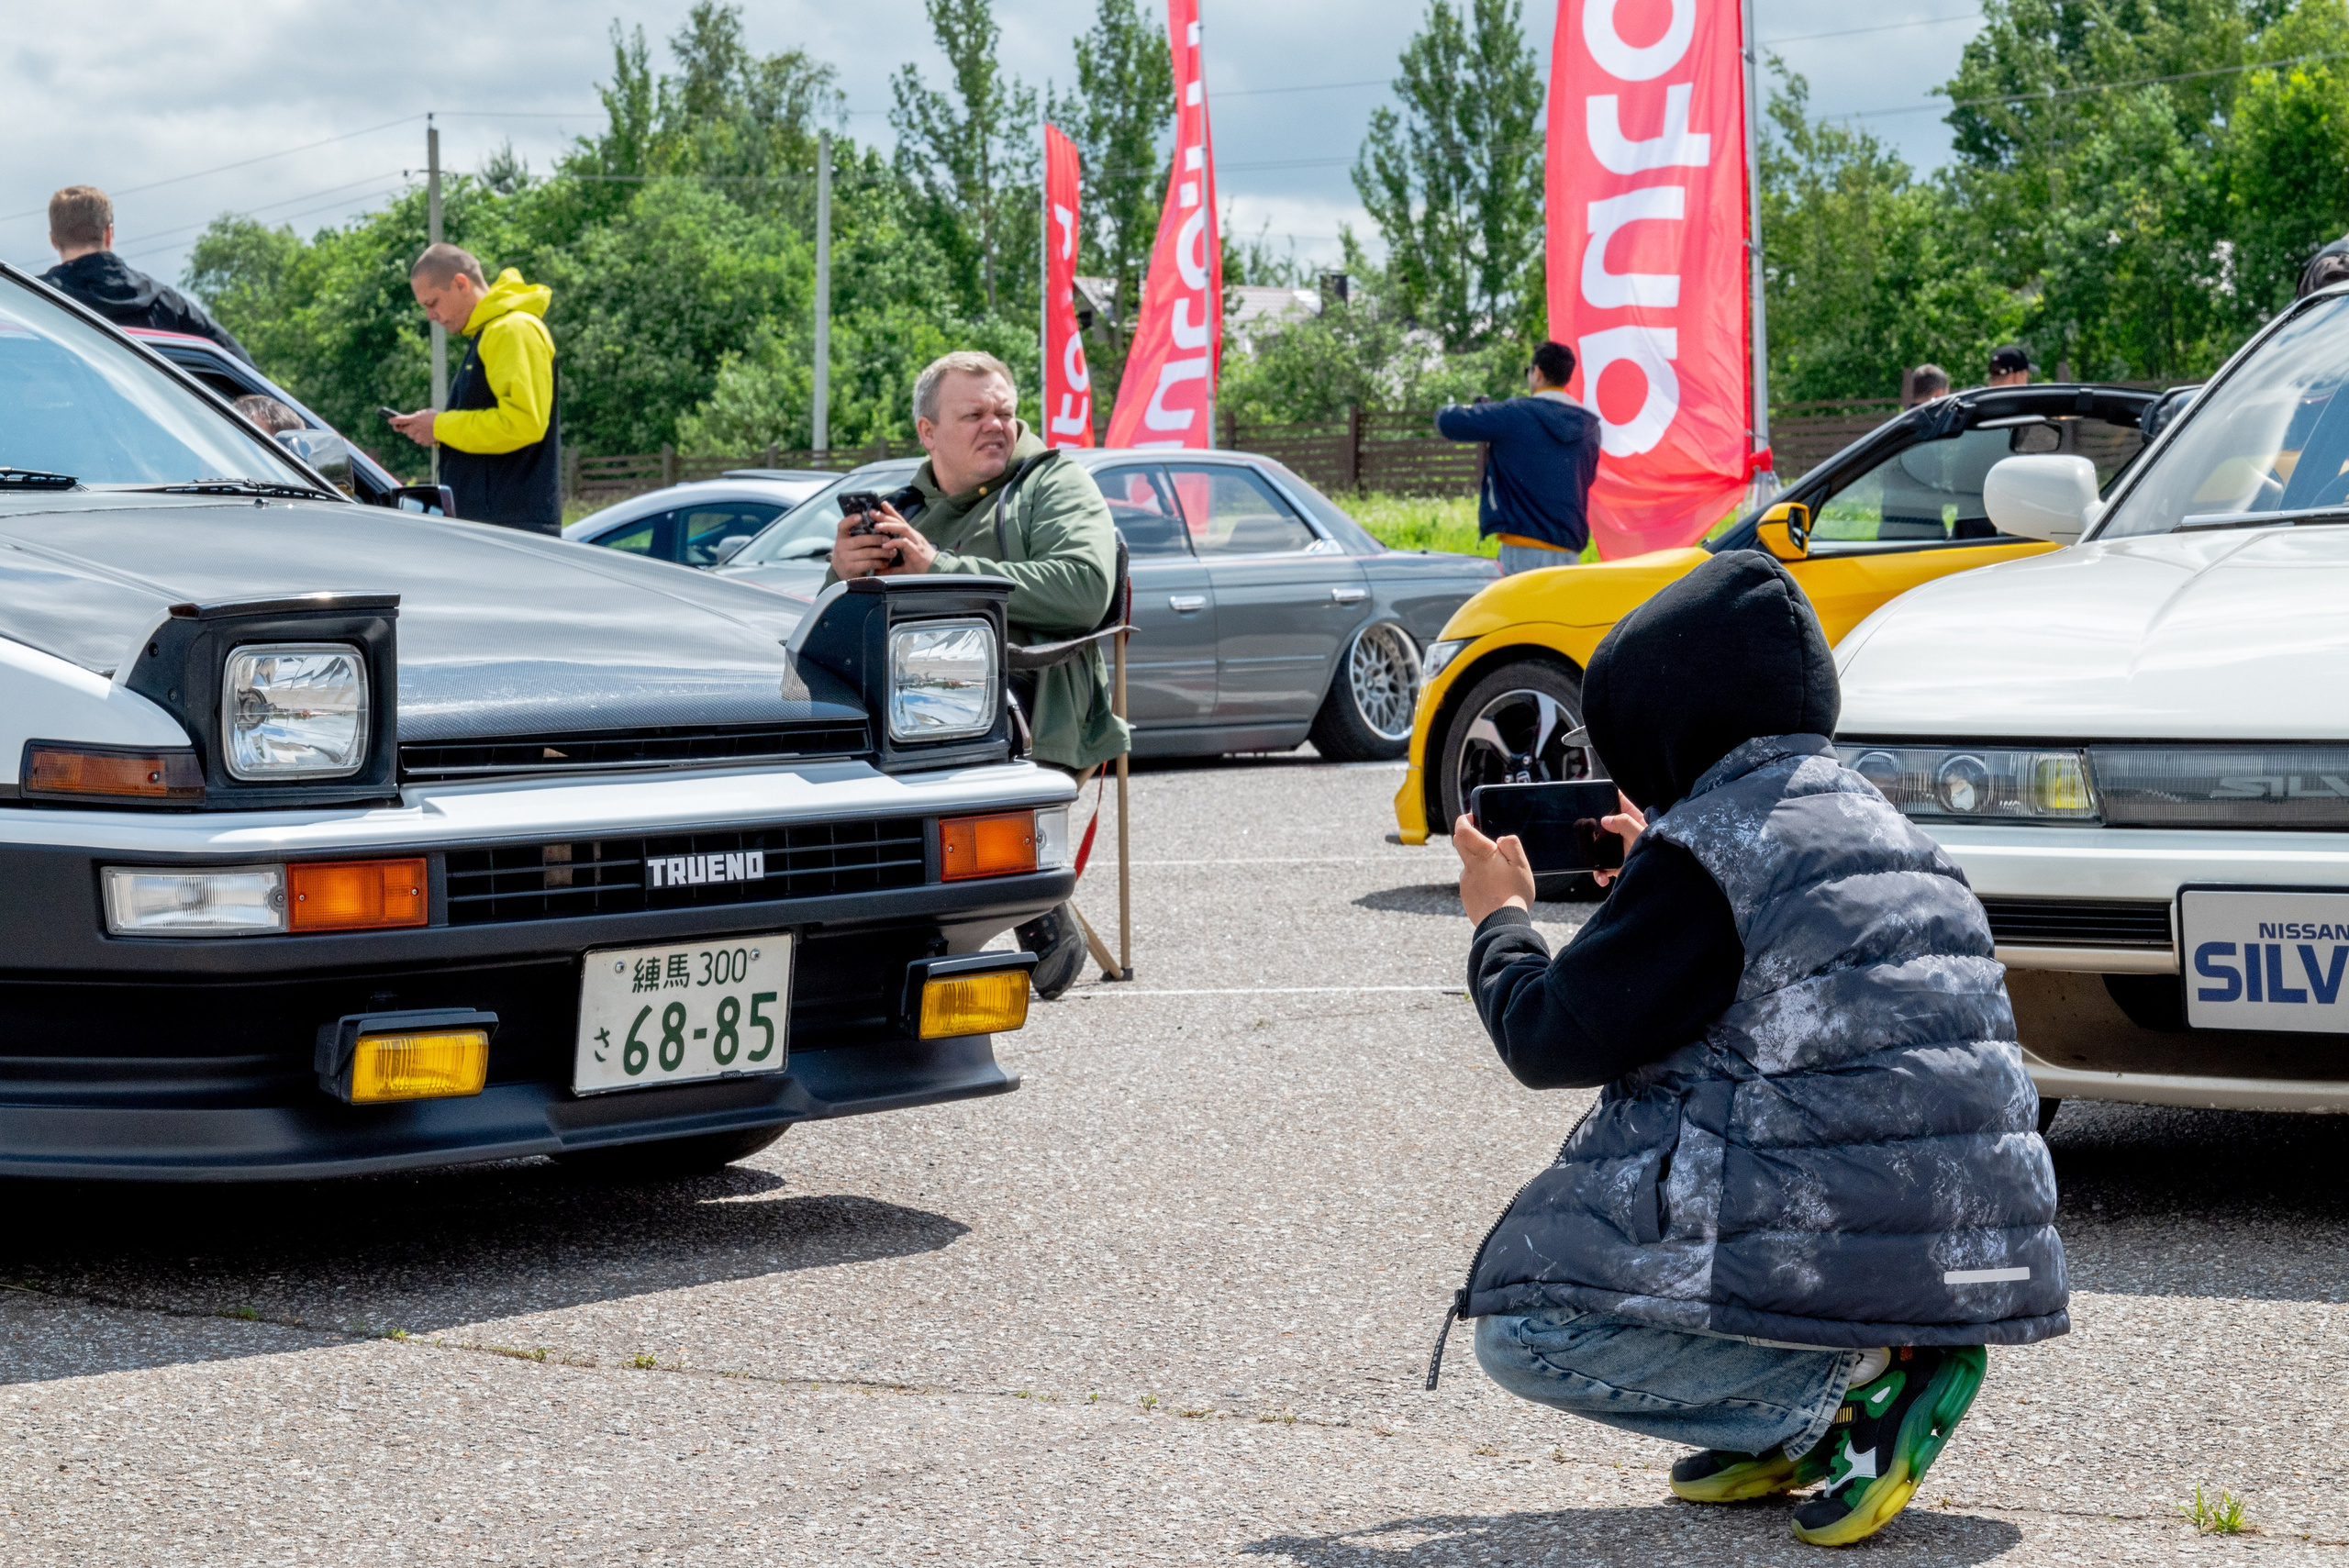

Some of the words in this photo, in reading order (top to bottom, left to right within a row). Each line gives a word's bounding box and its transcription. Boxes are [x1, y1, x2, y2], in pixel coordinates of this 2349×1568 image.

[647, 851, 764, 887] TRUENO
[2259, 922, 2349, 940] NISSAN
[632, 953, 690, 993] 練馬
[696, 948, 747, 986] 300
[2194, 941, 2349, 1004] SILV
[594, 1027, 610, 1062] さ
[623, 991, 777, 1075] 68-85
